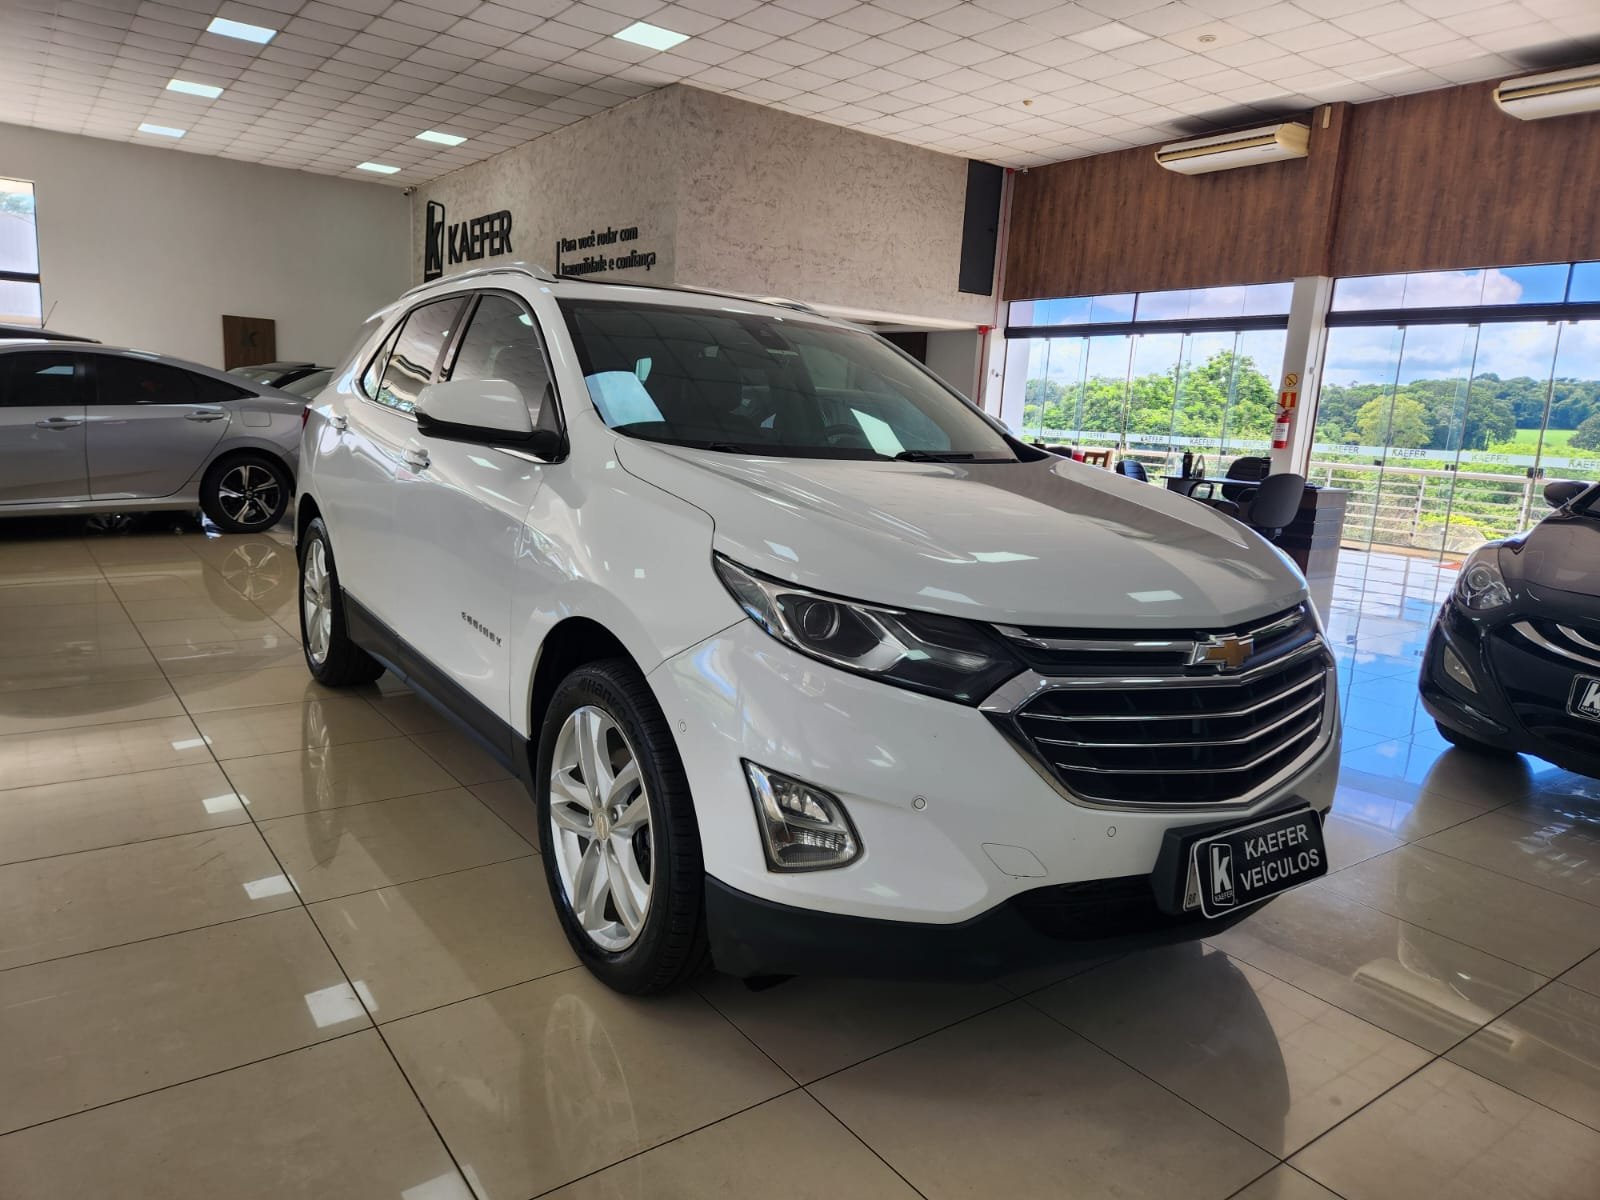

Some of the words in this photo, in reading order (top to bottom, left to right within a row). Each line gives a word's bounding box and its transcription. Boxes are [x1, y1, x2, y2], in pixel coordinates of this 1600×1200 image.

[448, 210, 512, 265] KAEFER
[561, 238, 577, 253] Para
[578, 230, 596, 250] você
[597, 226, 618, 247] rodar
[620, 226, 639, 242] com
[608, 258, 615, 271] e
[616, 249, 657, 271] confiança
[1391, 449, 1427, 458] KAEFER
[1244, 824, 1309, 860] KAEFER
[1240, 848, 1320, 891] VEÍCULOS
[1214, 890, 1234, 902] KAEFER
